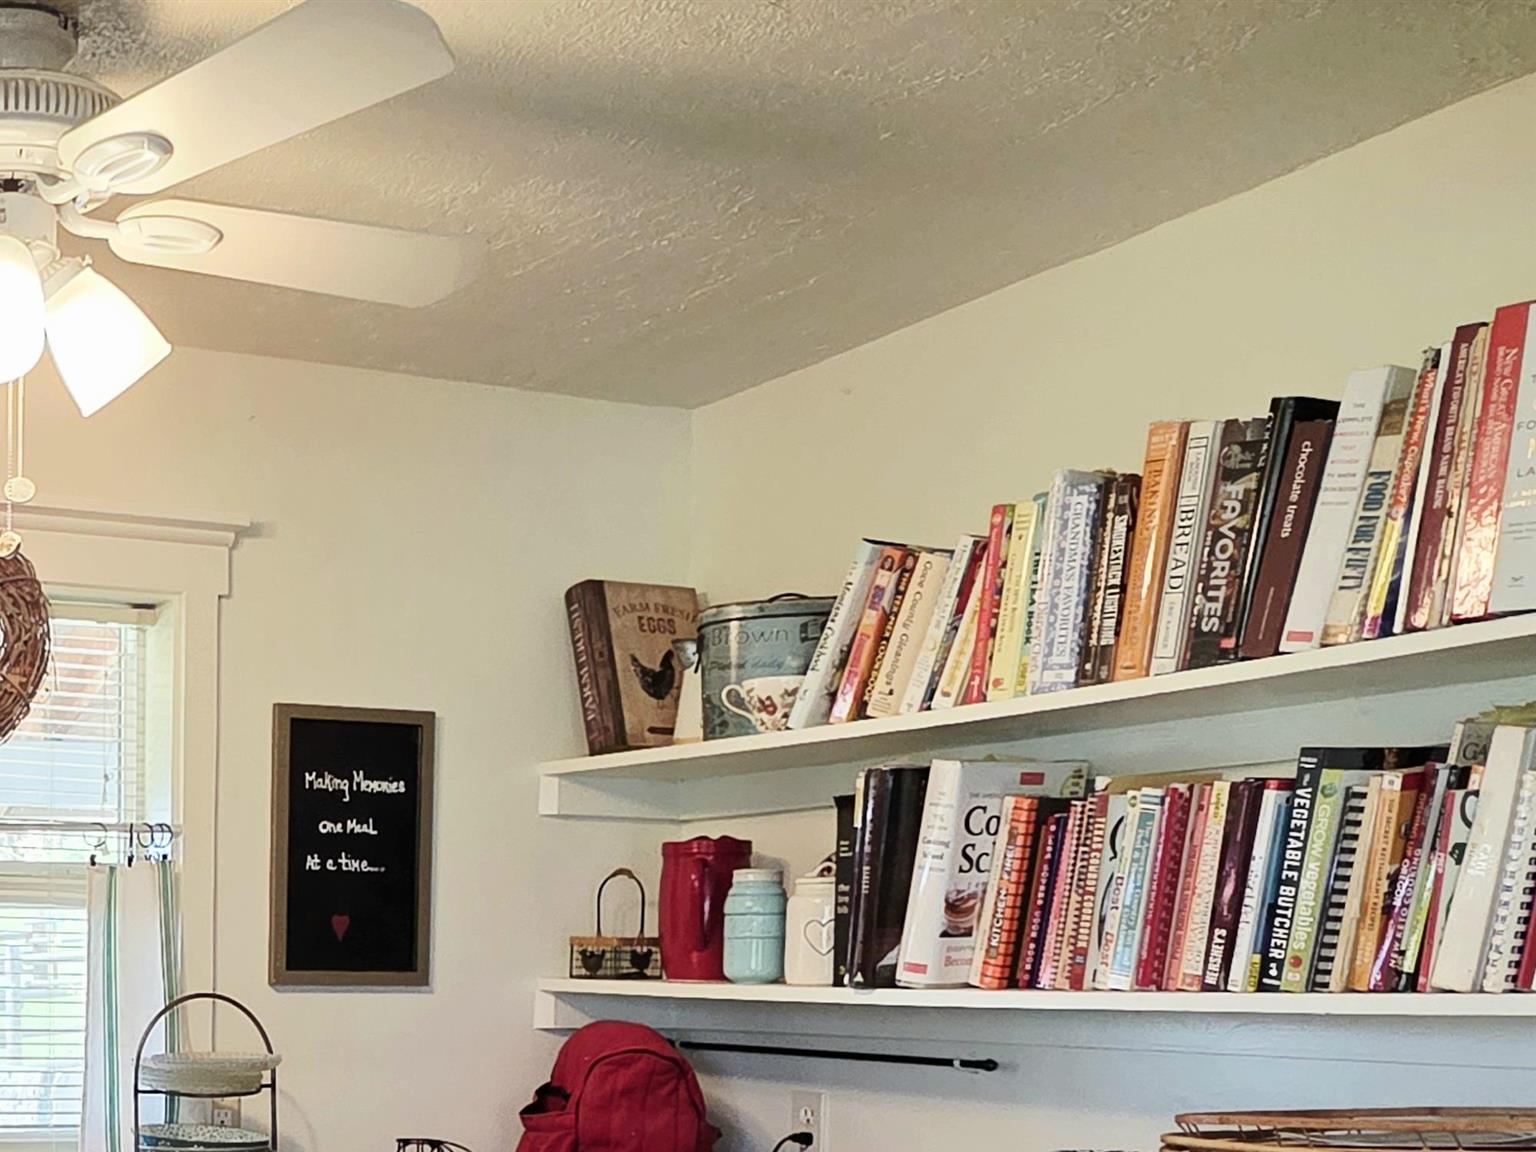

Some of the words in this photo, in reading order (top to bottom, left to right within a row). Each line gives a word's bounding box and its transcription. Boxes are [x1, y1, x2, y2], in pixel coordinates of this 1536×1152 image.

[1441, 425, 1454, 453] BRAND
[1288, 439, 1314, 503] chocolate
[1437, 453, 1450, 478] NAME
[1363, 470, 1391, 518] FOOD
[1279, 503, 1298, 539] treats
[1352, 515, 1379, 546] FOR
[1107, 513, 1128, 587] SMOKESTACK
[1167, 507, 1194, 591] BREAD
[1199, 483, 1245, 635] FAVORITES
[1338, 547, 1370, 593] FIFTY
[637, 615, 676, 635] EGGS
[710, 625, 789, 646] Brown
[901, 589, 923, 630] County
[1054, 584, 1075, 657] FAVORITES
[882, 631, 910, 687] Gleanings
[305, 771, 349, 802] Making
[353, 770, 406, 794] Memories
[1092, 815, 1106, 849] TEXAS
[1280, 784, 1313, 881] VEGETABLE
[1309, 803, 1329, 857] GROW
[305, 853, 321, 871] At
[326, 860, 337, 871] a
[1391, 857, 1412, 907] OREGON
[989, 888, 1007, 947] KITCHEN
[1076, 894, 1093, 948] COOKBOOK
[1267, 884, 1295, 959] BUTCHER
[1291, 859, 1323, 951] vegetables
[1387, 937, 1401, 967] NEW
[1394, 906, 1408, 938] KETO
[1401, 848, 1423, 905] COOKING
[1205, 927, 1227, 985] HERSHEY'S
[1247, 960, 1259, 987] USED
